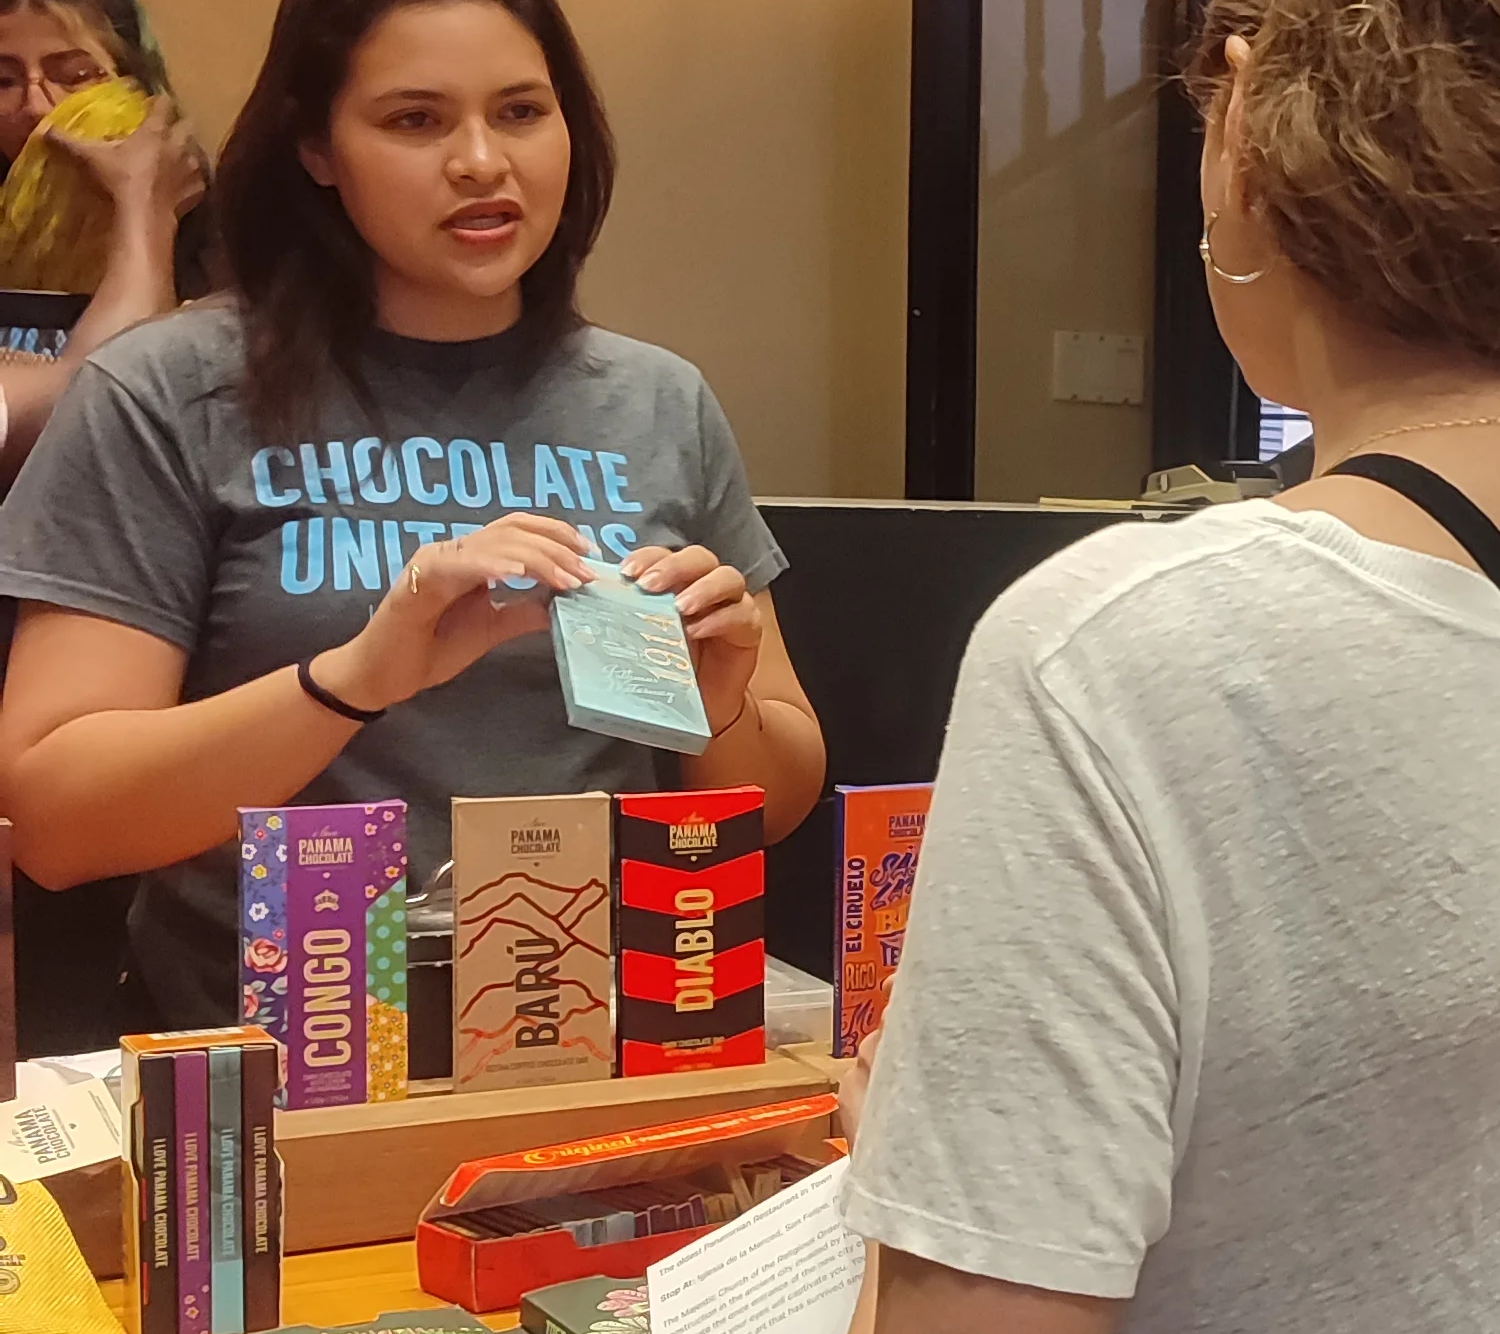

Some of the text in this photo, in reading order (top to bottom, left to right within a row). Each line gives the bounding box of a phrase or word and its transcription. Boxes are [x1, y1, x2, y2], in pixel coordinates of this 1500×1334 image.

[251, 436, 643, 512] CHOCOLATE
[511, 828, 560, 844] PANAMA
[669, 822, 718, 841] PANAMA
[889, 813, 926, 828] PANAM
[298, 837, 354, 854] PANAMA
[298, 852, 354, 866] CHOCOLATE
[511, 842, 561, 855] CHOCOLATE
[669, 836, 718, 850] CHOCOLATE
[845, 856, 867, 953] EL CIRUELO
[674, 888, 714, 1013] DIABLO
[302, 928, 352, 1068] CONGO
[506, 937, 560, 1049] BARÚ
[14, 1108, 57, 1164] PANAMA
[33, 1104, 71, 1160] CHOCOLATE
[184, 1137, 198, 1162] LOVE
[220, 1134, 234, 1158] LOVE
[253, 1131, 267, 1156] LOVE
[153, 1142, 167, 1169] LOVE
[153, 1169, 168, 1212] PANAMA
[185, 1163, 199, 1206] PANAMA
[222, 1159, 235, 1200] PANAMA
[254, 1157, 267, 1199] PANAMA
[154, 1212, 168, 1268] CHOCOLATE
[186, 1206, 200, 1261] CHOCOLATE
[255, 1199, 268, 1254] CHOCOLATE
[659, 1265, 675, 1277] The
[676, 1248, 702, 1268] oldest
[753, 1193, 799, 1221] Restaurant
[800, 1187, 809, 1197] in
[810, 1174, 833, 1190] Town
[660, 1286, 681, 1303] Stop
[726, 1255, 738, 1266] de
[739, 1249, 748, 1259] la
[785, 1219, 802, 1232] San
[719, 1302, 728, 1312] in
[728, 1293, 744, 1305] the
[829, 1237, 842, 1250] by
[663, 1315, 679, 1329] The
[718, 1276, 749, 1298] Church
[750, 1269, 760, 1280] of
[761, 1260, 776, 1273] the
[711, 1317, 727, 1329] the
[790, 1272, 800, 1284] of
[800, 1263, 816, 1278] the
[837, 1244, 854, 1259] city
[754, 1322, 768, 1334] art
[768, 1312, 786, 1327] that
[787, 1302, 805, 1315] has
